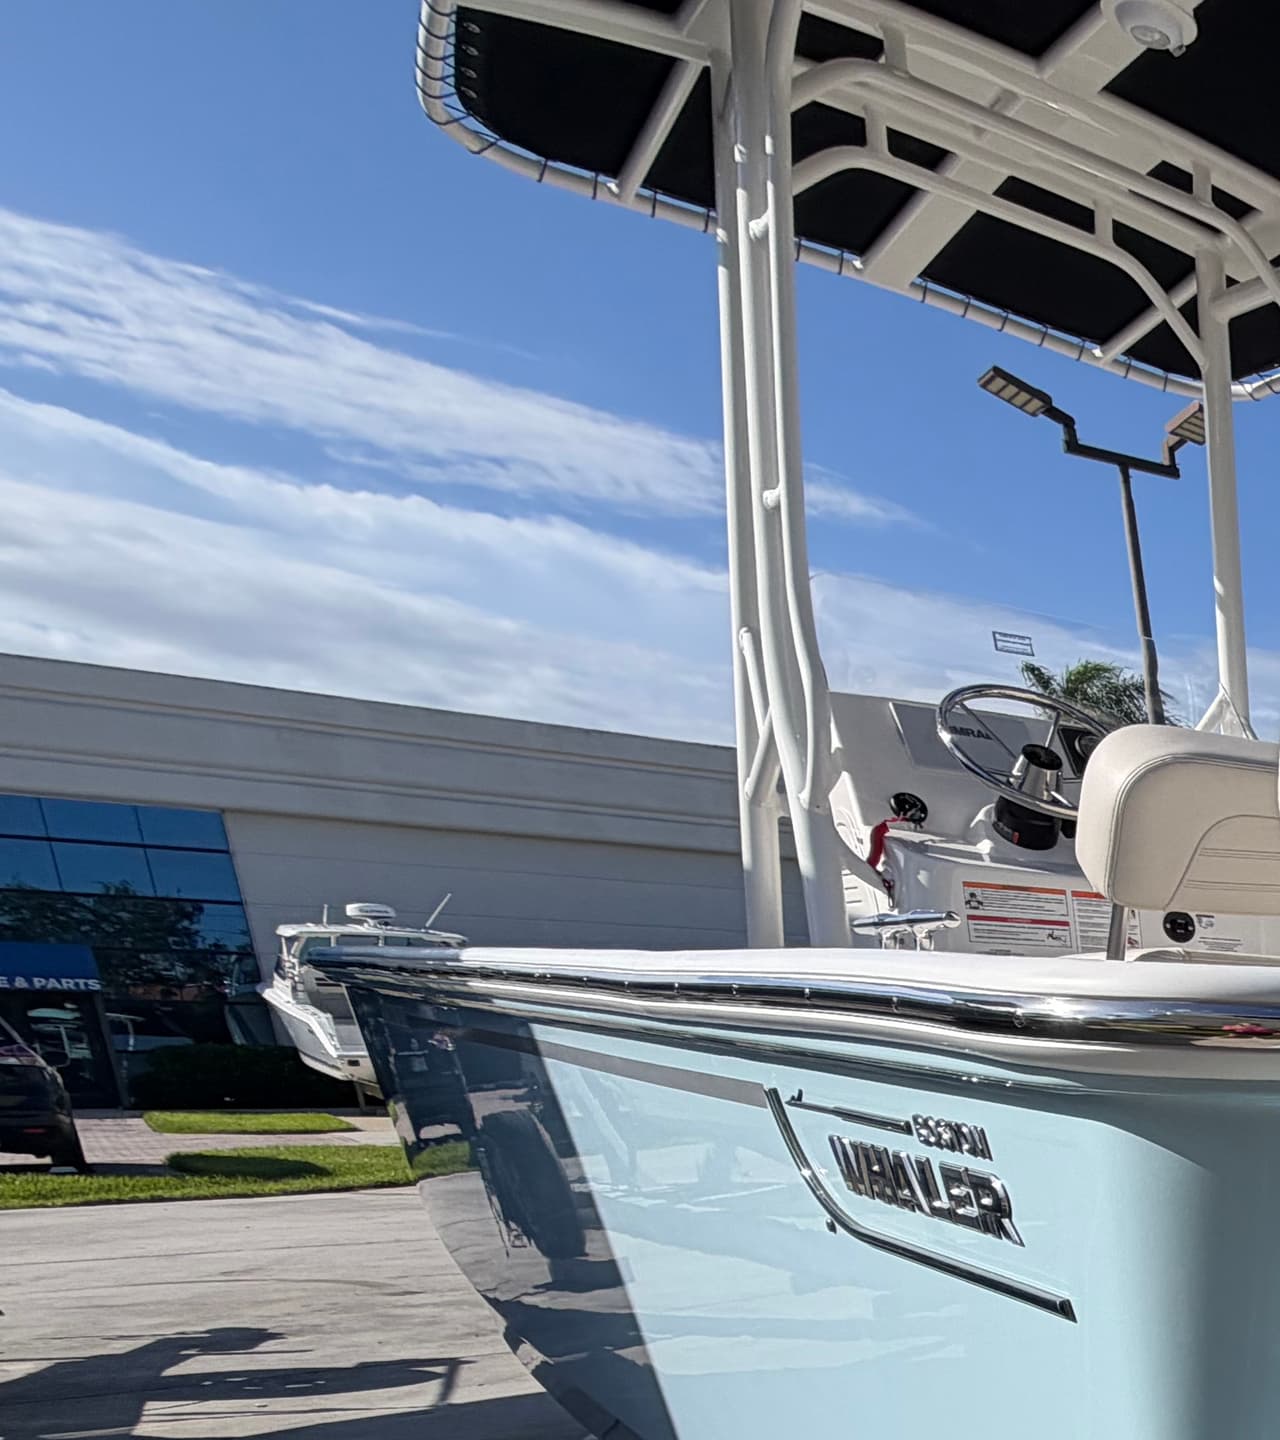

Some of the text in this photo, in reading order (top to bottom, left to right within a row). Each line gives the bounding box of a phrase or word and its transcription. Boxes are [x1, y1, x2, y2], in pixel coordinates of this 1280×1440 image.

[14, 976, 29, 989] &
[31, 977, 102, 990] PARTS
[828, 1134, 1026, 1248] WHALER
